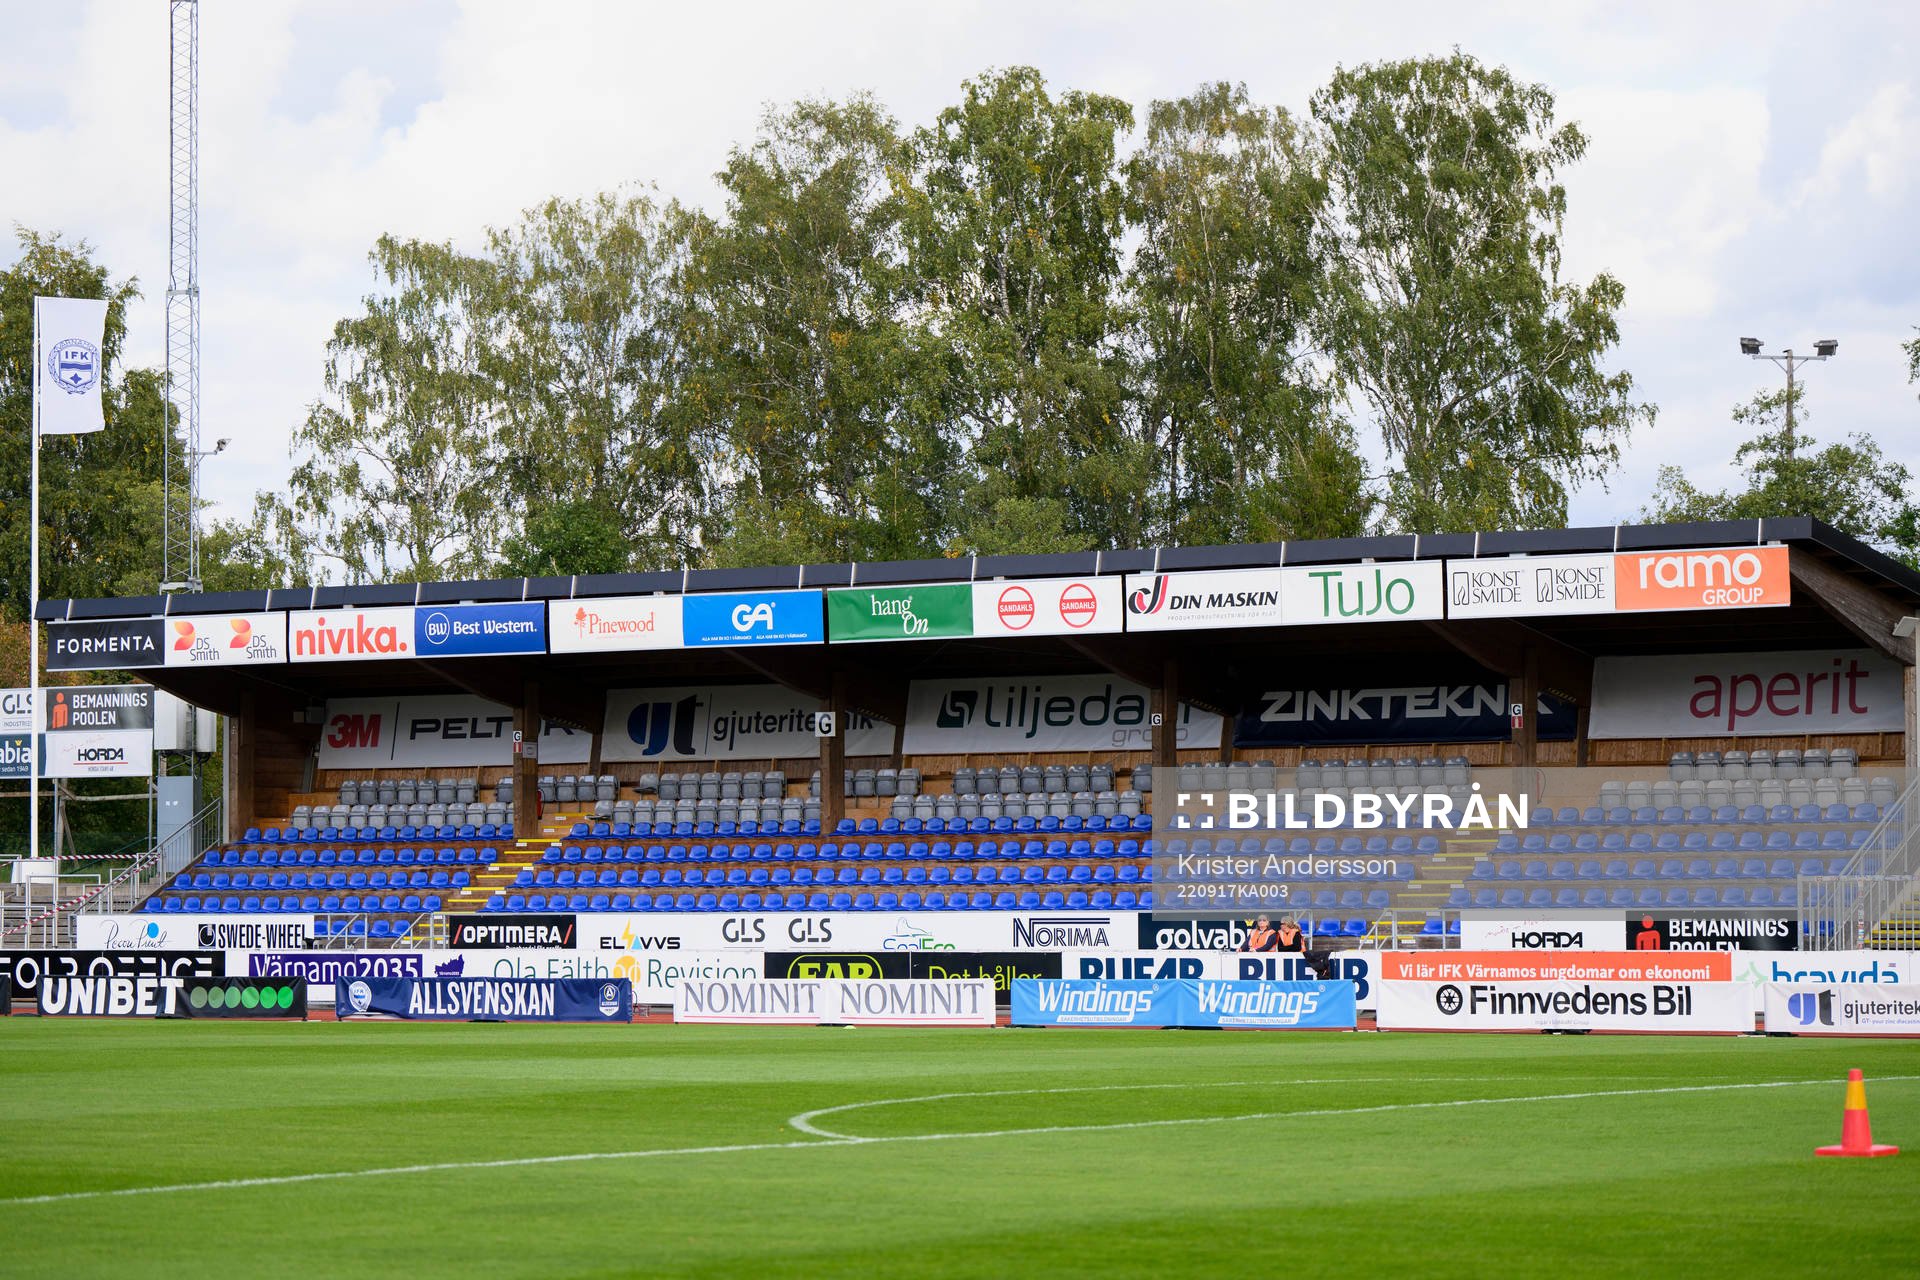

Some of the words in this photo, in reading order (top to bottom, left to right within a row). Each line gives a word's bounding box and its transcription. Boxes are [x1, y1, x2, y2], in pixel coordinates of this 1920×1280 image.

[65, 351, 89, 361] IFK
[1472, 570, 1520, 587] KONST
[1556, 566, 1604, 584] KONST
[1639, 553, 1762, 589] ramo
[1169, 594, 1202, 610] DIN
[1205, 590, 1279, 608] MASKIN
[1308, 568, 1415, 617] TuJo
[1472, 586, 1522, 604] SMIDE
[1556, 583, 1606, 600] SMIDE
[1702, 587, 1764, 605] GROUP
[871, 594, 912, 617] hang
[999, 603, 1033, 613] SANDAHLS
[1061, 600, 1096, 611] SANDAHLS
[588, 611, 655, 635] Pinewood
[731, 603, 774, 632] GA
[903, 611, 929, 635] On
[428, 622, 448, 635] BW
[453, 621, 481, 635] Best
[56, 635, 155, 655] FORMENTA
[196, 637, 210, 650] DS
[246, 644, 278, 659] Smith
[252, 635, 267, 648] DS
[190, 647, 220, 661] Smith
[72, 692, 148, 709] BEMANNINGS
[1689, 658, 1870, 732] aperit
[72, 711, 117, 726] POOLEN
[985, 684, 1191, 739] Liljedal
[1152, 714, 1161, 725] G
[1513, 704, 1521, 716] G
[327, 713, 382, 749] 3M
[818, 713, 832, 735] G
[513, 731, 521, 742] G
[78, 748, 124, 761] HORDA
[722, 918, 766, 943] GLS
[788, 918, 832, 943] GLS
[1668, 918, 1789, 937] BEMANNINGS
[1511, 931, 1583, 948] HORDA
[494, 956, 536, 979] Ola
[648, 957, 757, 988] Revision
[1400, 964, 1413, 978] Vi
[1416, 963, 1436, 978] lär
[1439, 964, 1462, 978] IFK
[1466, 963, 1537, 979] Värnamos
[1540, 963, 1615, 981] ungdomar
[1618, 967, 1642, 979] om
[1645, 965, 1711, 979] ekonomi
[1239, 957, 1370, 1001] BUFB
[41, 978, 185, 1014] UNIBET
[408, 981, 555, 1016] ALLSVENSKAN
[683, 982, 821, 1014] NOMINIT
[840, 982, 984, 1015] NOMINIT
[1038, 981, 1152, 1022] Windings
[1199, 982, 1320, 1023] Windings
[1470, 984, 1648, 1016] Finnvedens
[1653, 985, 1692, 1016] Bil
